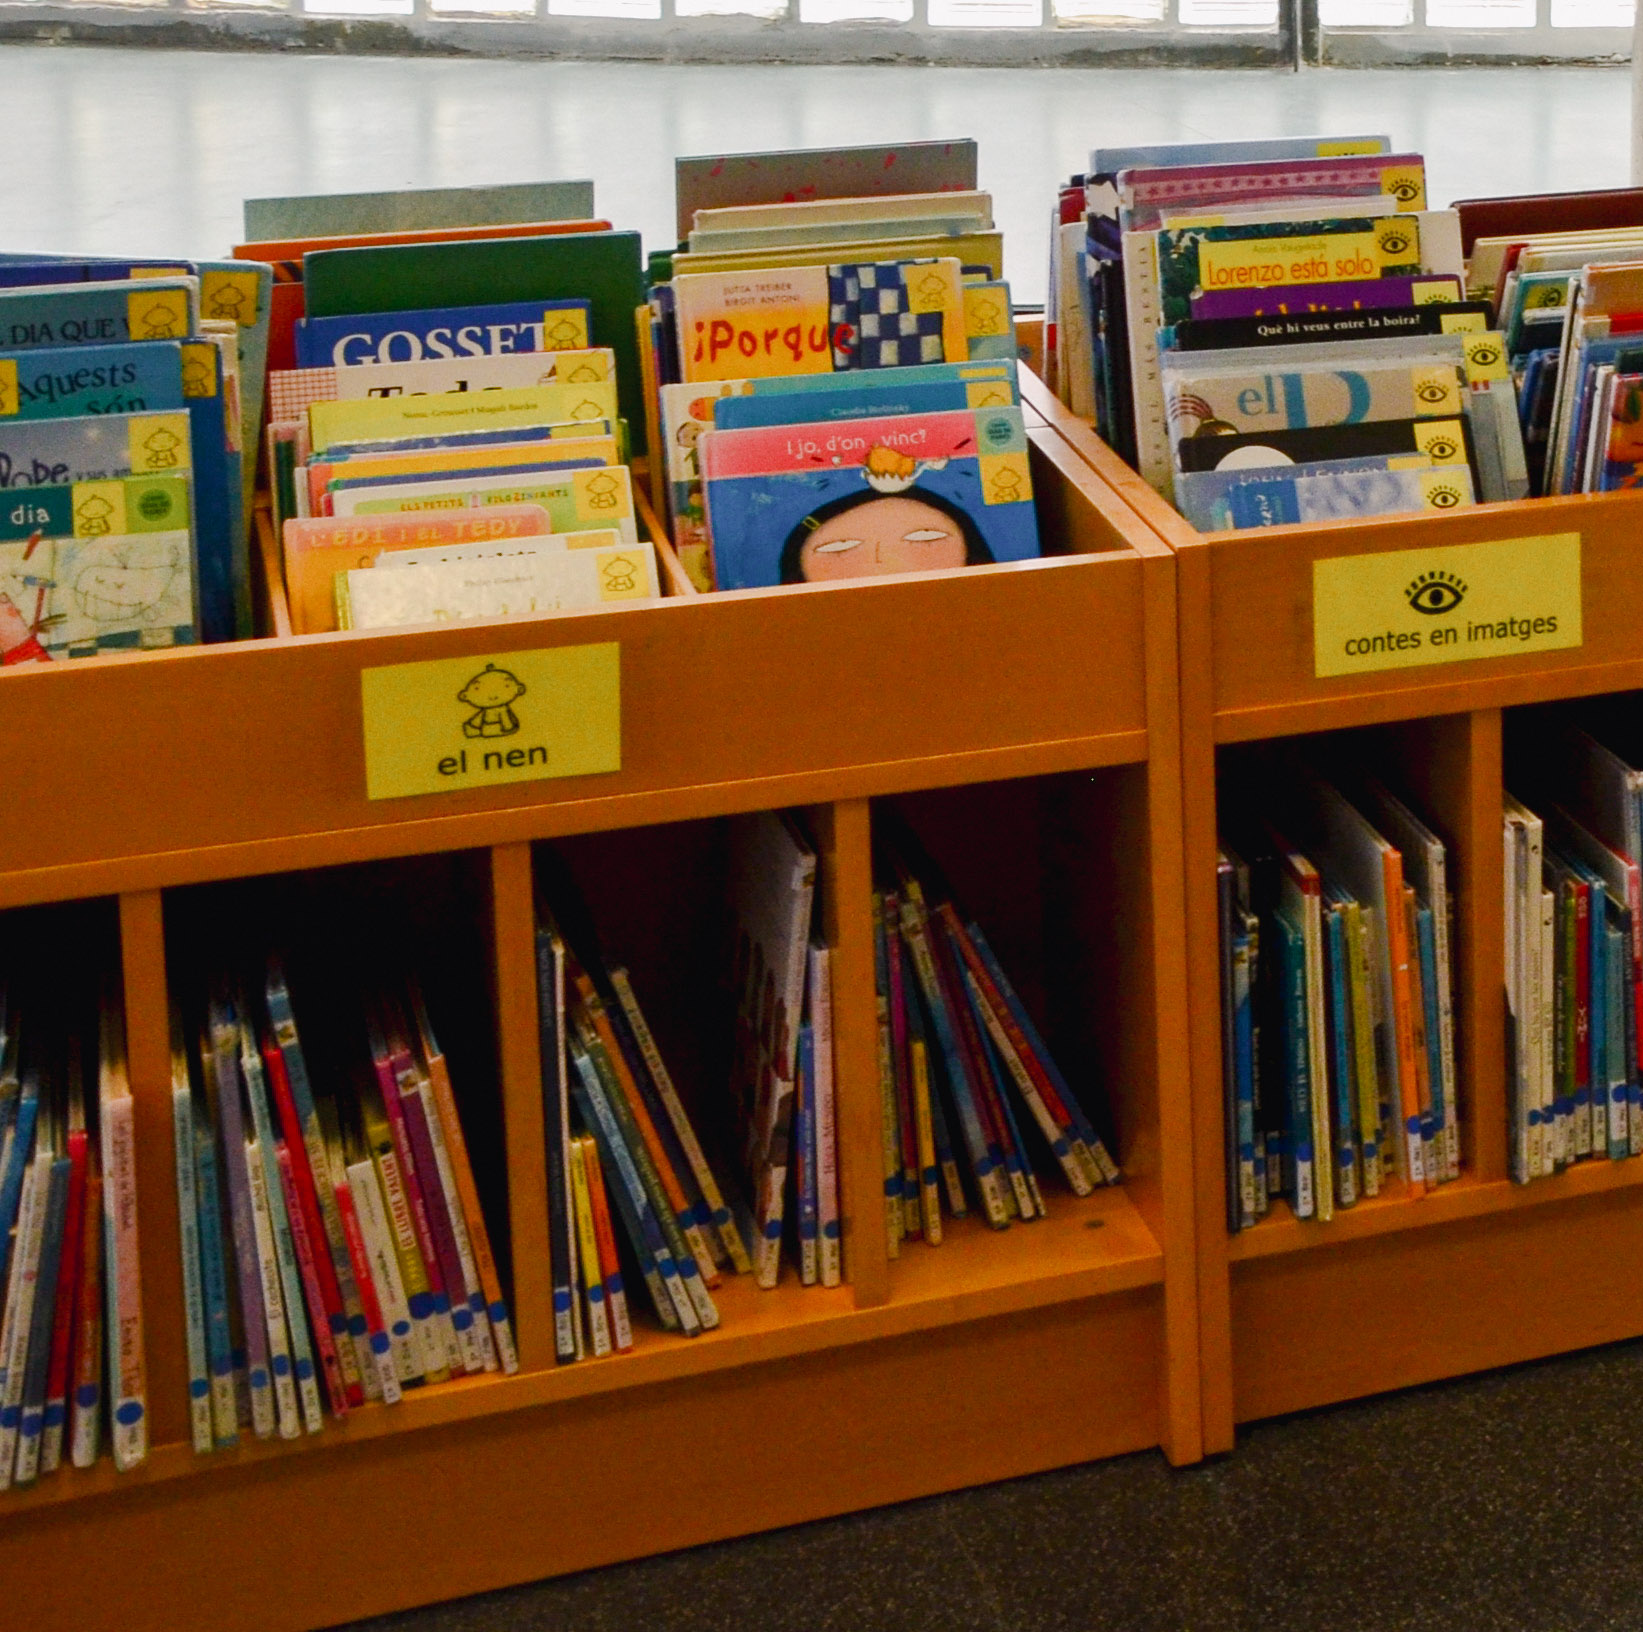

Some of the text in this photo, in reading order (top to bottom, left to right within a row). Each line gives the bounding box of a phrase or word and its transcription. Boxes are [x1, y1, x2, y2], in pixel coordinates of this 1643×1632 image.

[1207, 248, 1373, 286] Lorenzo está solo
[11, 317, 117, 345] DIA QUE
[693, 320, 856, 364] ¡Porque
[1257, 323, 1283, 337] Què
[1286, 321, 1299, 333] hi
[1303, 321, 1330, 333] veus
[1333, 318, 1365, 329] entre
[1368, 317, 1380, 327] la
[18, 362, 137, 407] Aquests
[1237, 373, 1278, 417] el
[826, 435, 866, 453] d'on
[881, 429, 927, 448] vinc?
[11, 503, 50, 525] dia
[1345, 616, 1558, 656] contes en imatges
[438, 746, 548, 776] el nen
